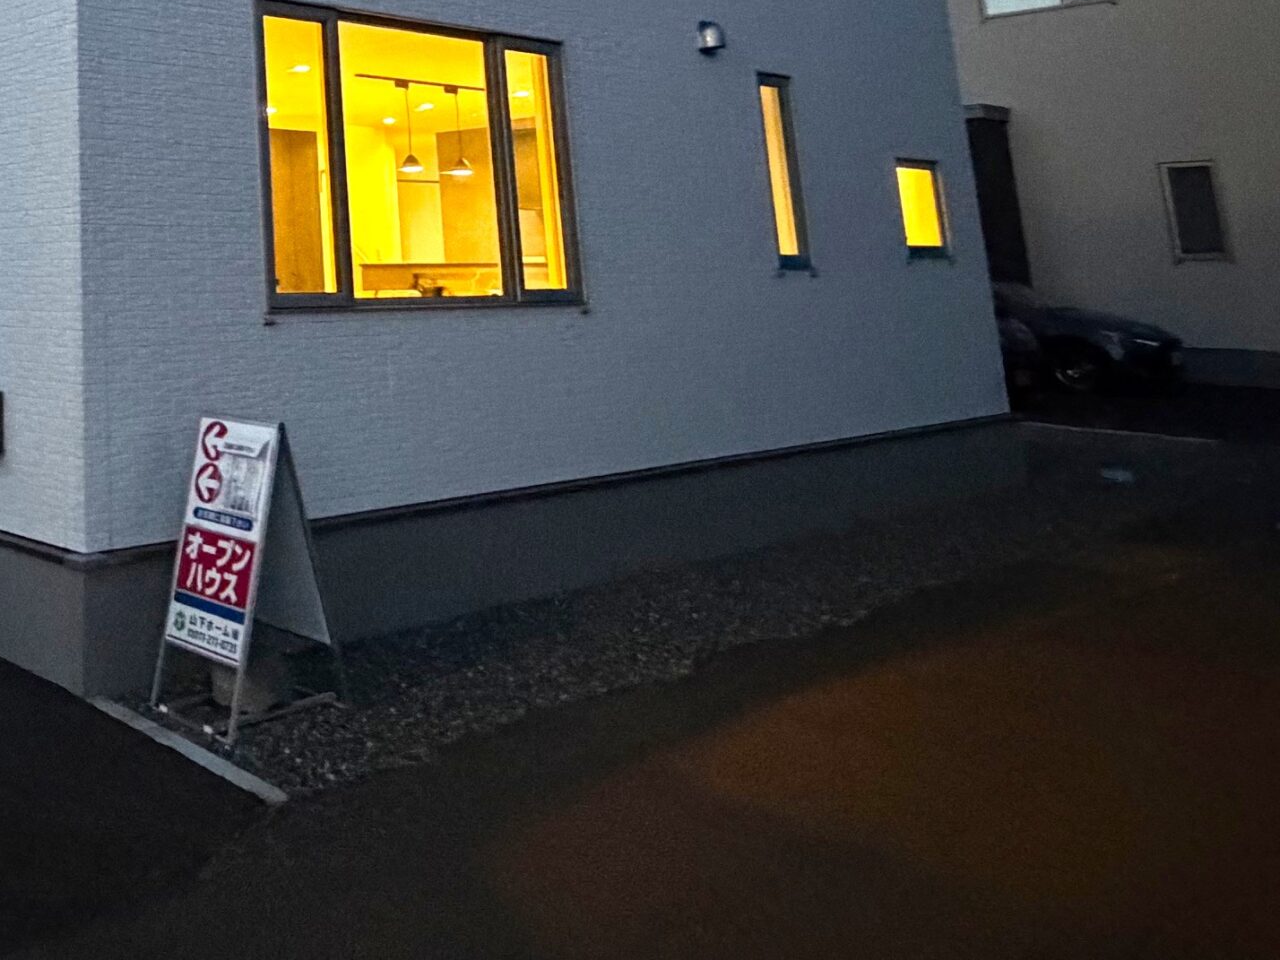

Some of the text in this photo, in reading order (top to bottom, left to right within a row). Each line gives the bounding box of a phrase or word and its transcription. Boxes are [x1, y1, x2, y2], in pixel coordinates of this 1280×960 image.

[185, 531, 251, 572] オープン
[186, 562, 238, 604] ハウス
